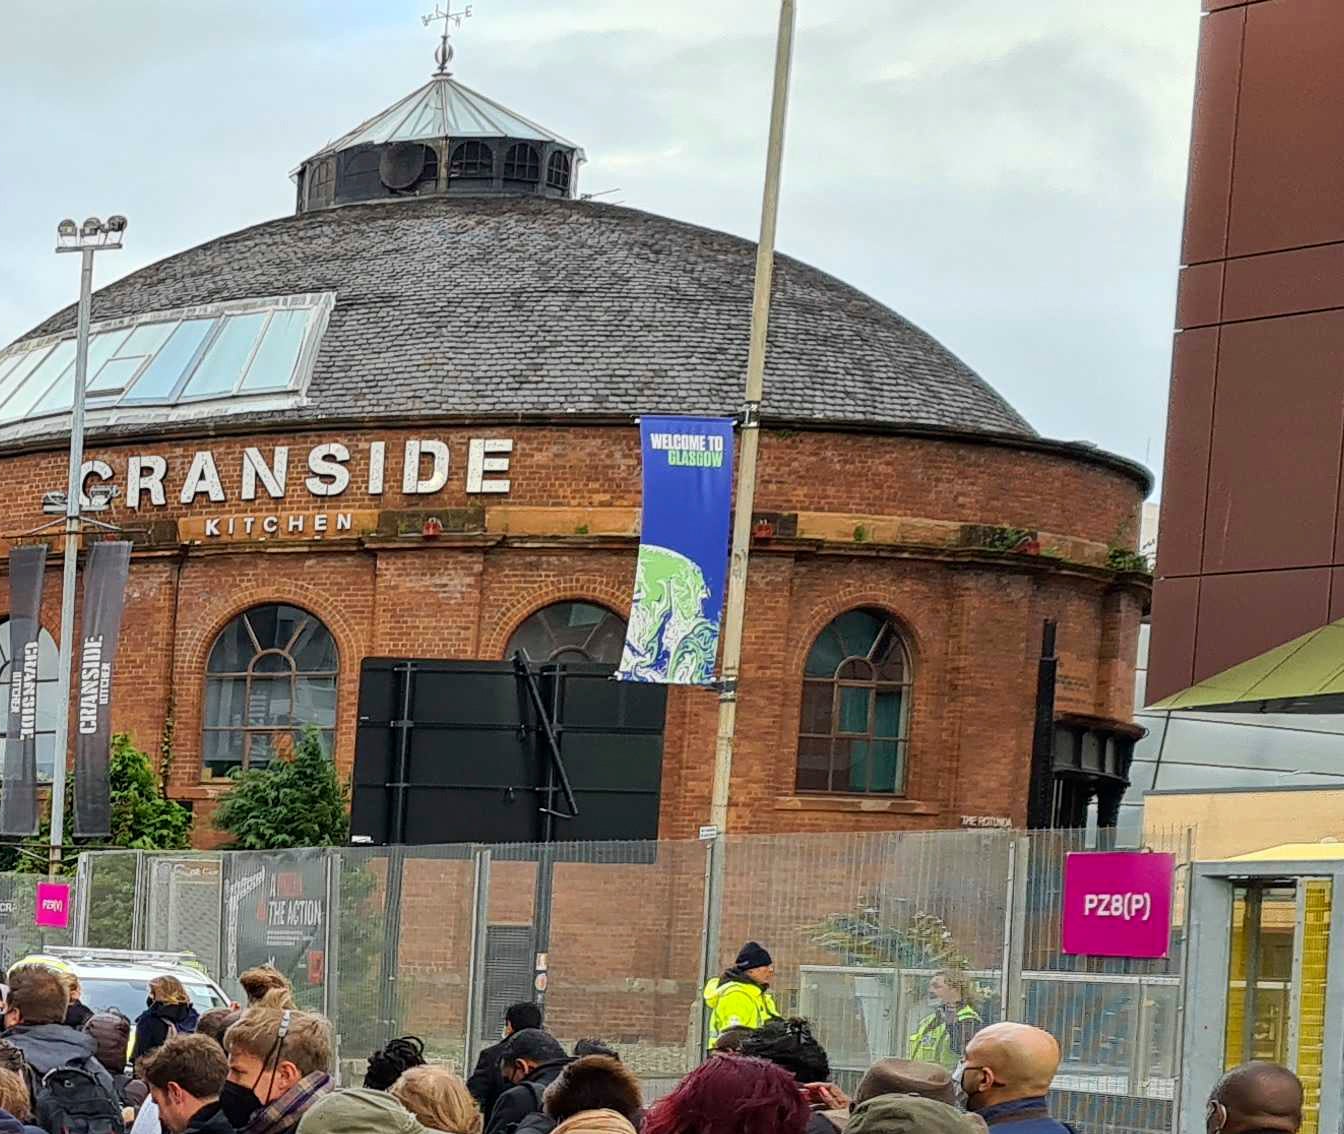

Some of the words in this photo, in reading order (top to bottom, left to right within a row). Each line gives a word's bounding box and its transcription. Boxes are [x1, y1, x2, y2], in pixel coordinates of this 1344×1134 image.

[651, 433, 705, 450] WELCOME
[707, 435, 723, 451] TO
[668, 449, 722, 467] GLASGOW
[79, 438, 514, 507] CRANSIDE
[204, 512, 353, 537] KITCHEN
[20, 640, 39, 741] CRANSIDE
[78, 634, 105, 735] CRANSIDE
[268, 899, 285, 926] THE
[287, 899, 322, 926] ACTION
[1084, 893, 1152, 921] PZ8(P)
